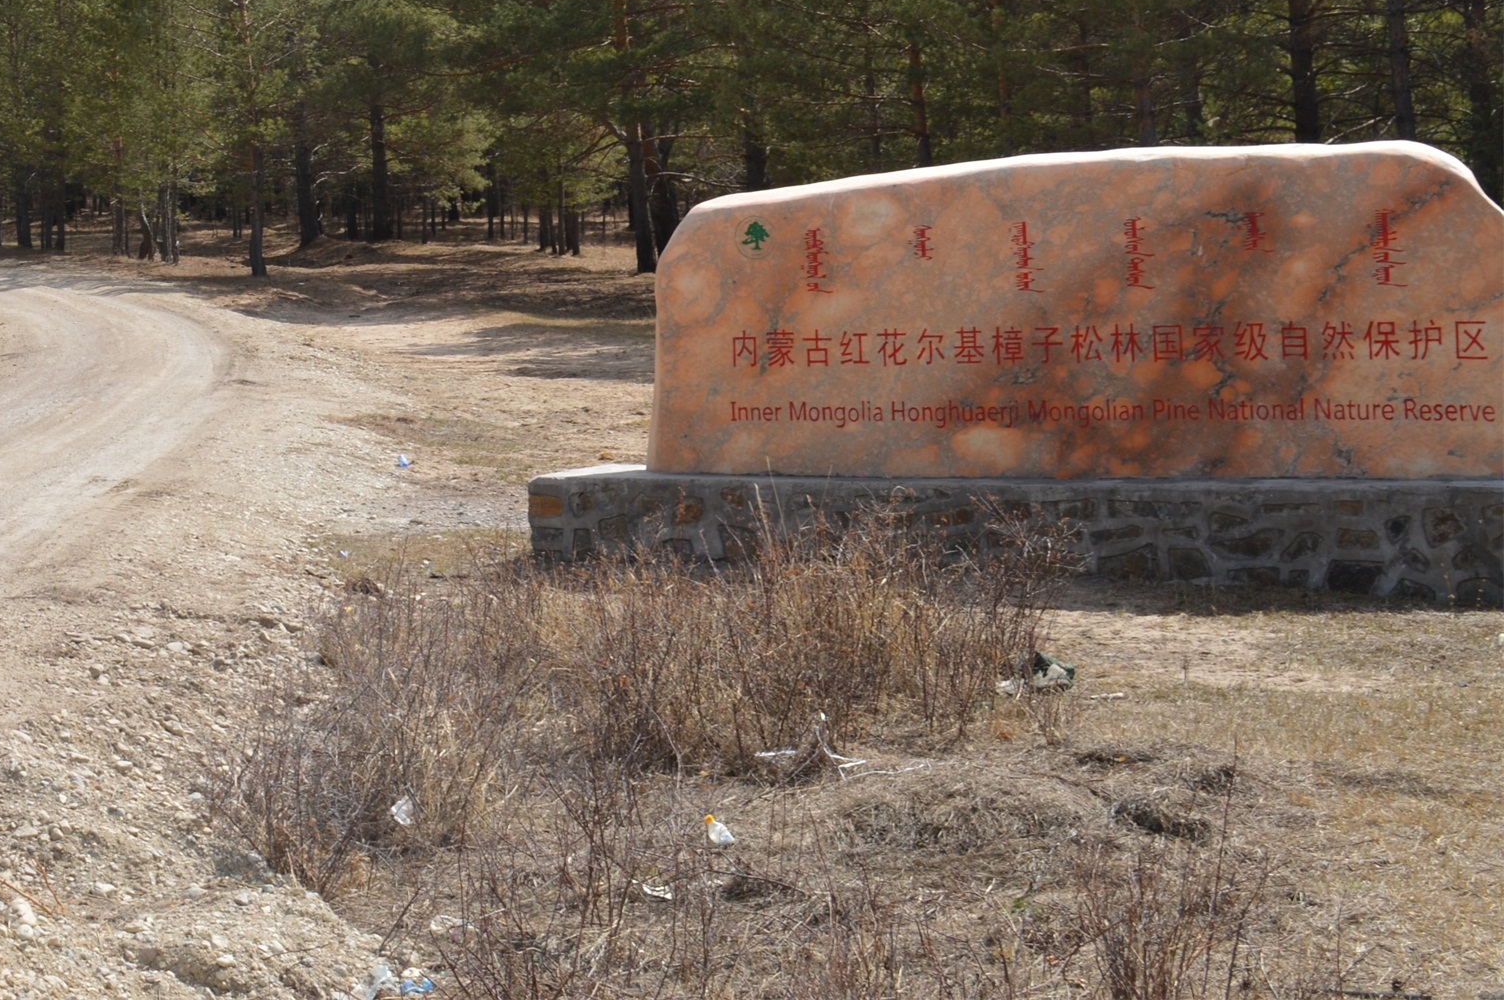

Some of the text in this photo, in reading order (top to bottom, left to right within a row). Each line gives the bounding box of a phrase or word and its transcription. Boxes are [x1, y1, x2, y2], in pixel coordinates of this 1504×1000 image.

[730, 319, 1488, 367] 内蒙古红花尔基樟子松林国家级自然保护区
[730, 398, 1496, 429] Inner Mongolia Honghuaerji Mongolian Pine National Nature Reserve
